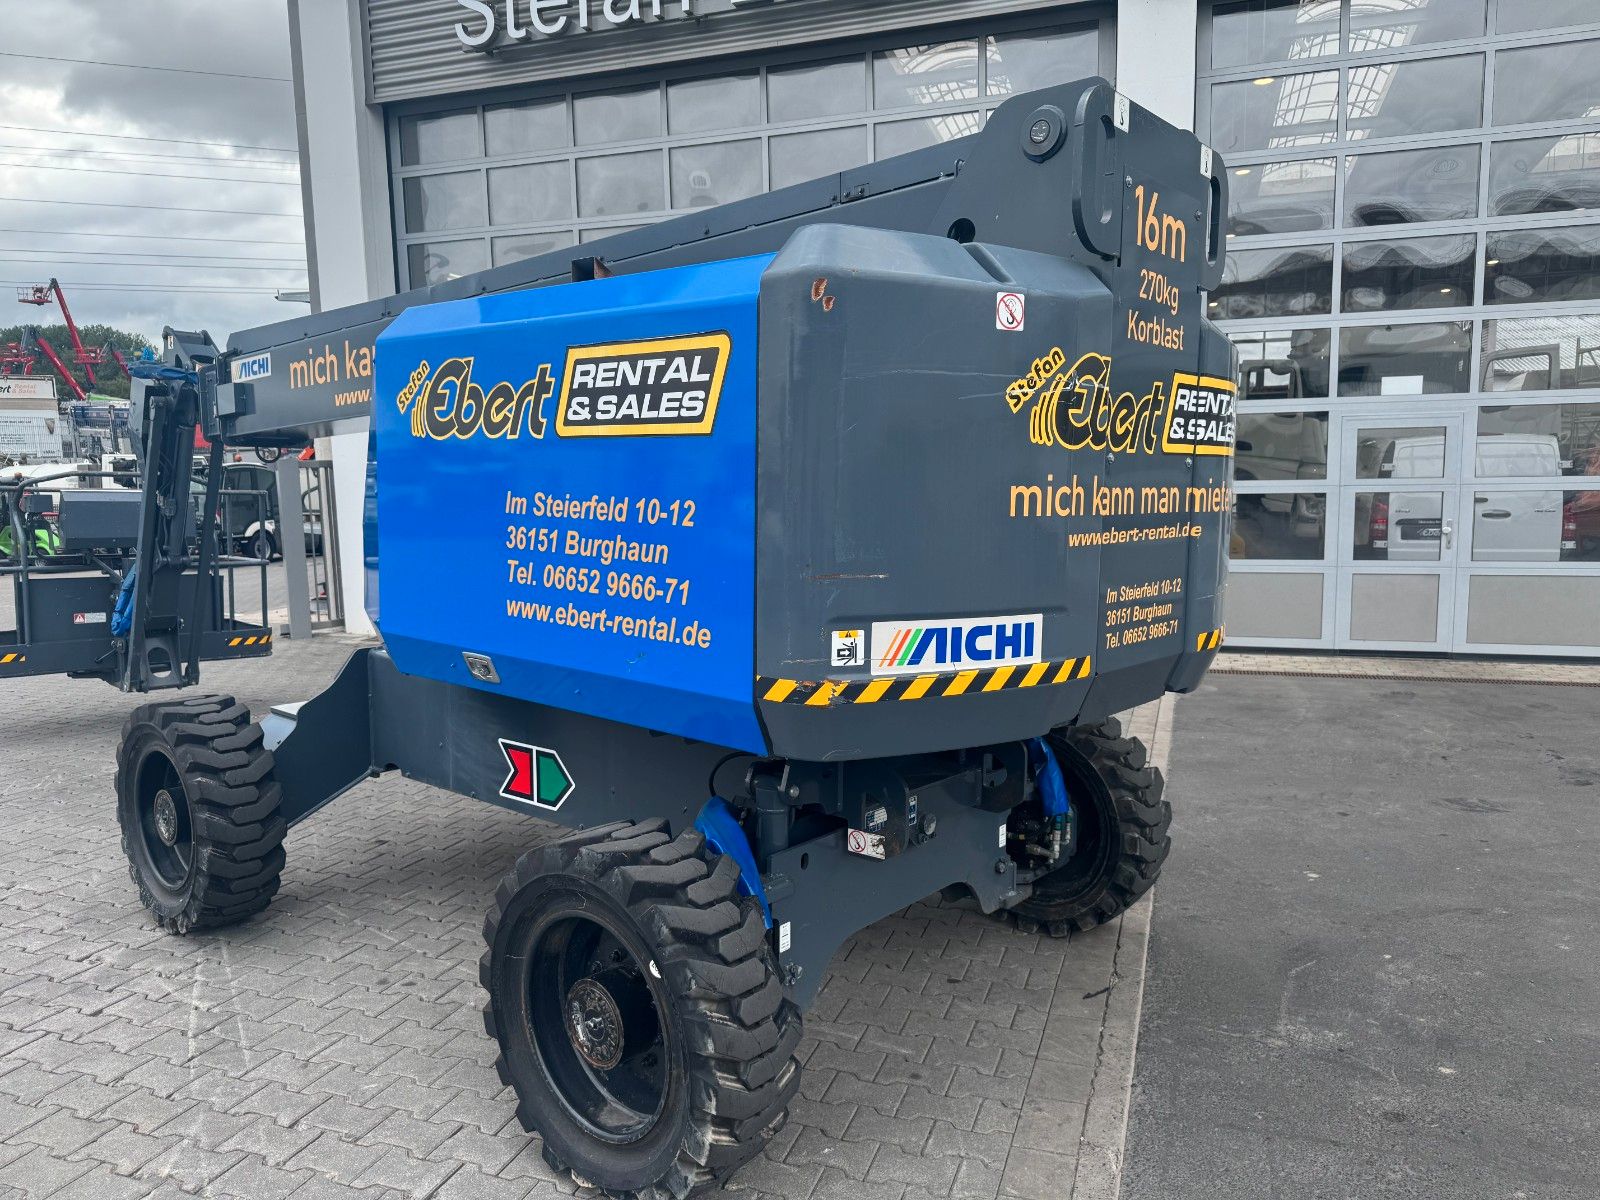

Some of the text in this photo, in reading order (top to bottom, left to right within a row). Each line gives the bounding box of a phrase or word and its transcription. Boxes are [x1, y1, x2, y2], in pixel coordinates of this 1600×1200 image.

[1135, 184, 1186, 263] 16m
[1139, 268, 1179, 316] 270kg
[1127, 309, 1185, 350] Korblast
[239, 356, 269, 379] AICHI
[289, 344, 338, 389] mich
[397, 360, 431, 414] Stefan
[572, 355, 711, 389] RENTAL
[1006, 346, 1066, 414] Stefan
[424, 356, 556, 440] Ebert
[567, 390, 707, 421] & SALES
[1051, 352, 1166, 454] Ebert
[1174, 388, 1236, 417] RENTA
[1169, 417, 1236, 443] & SALE
[505, 490, 696, 527] Im Steierfeld 10-12
[1009, 474, 1232, 517] mich kann man miete
[505, 525, 669, 566] 36151 Burghaun
[1068, 522, 1202, 547] wwwebert-rental.de
[507, 559, 690, 606] Tel. 06652 9666-71
[1105, 577, 1182, 604] Im Steierfeld 10-12
[506, 599, 712, 649] www.ebert-rental.de
[1105, 603, 1172, 627] 36151 Burghaun
[1105, 619, 1179, 650] Tel. 06652 9666-71
[906, 621, 1035, 666] AICHI
